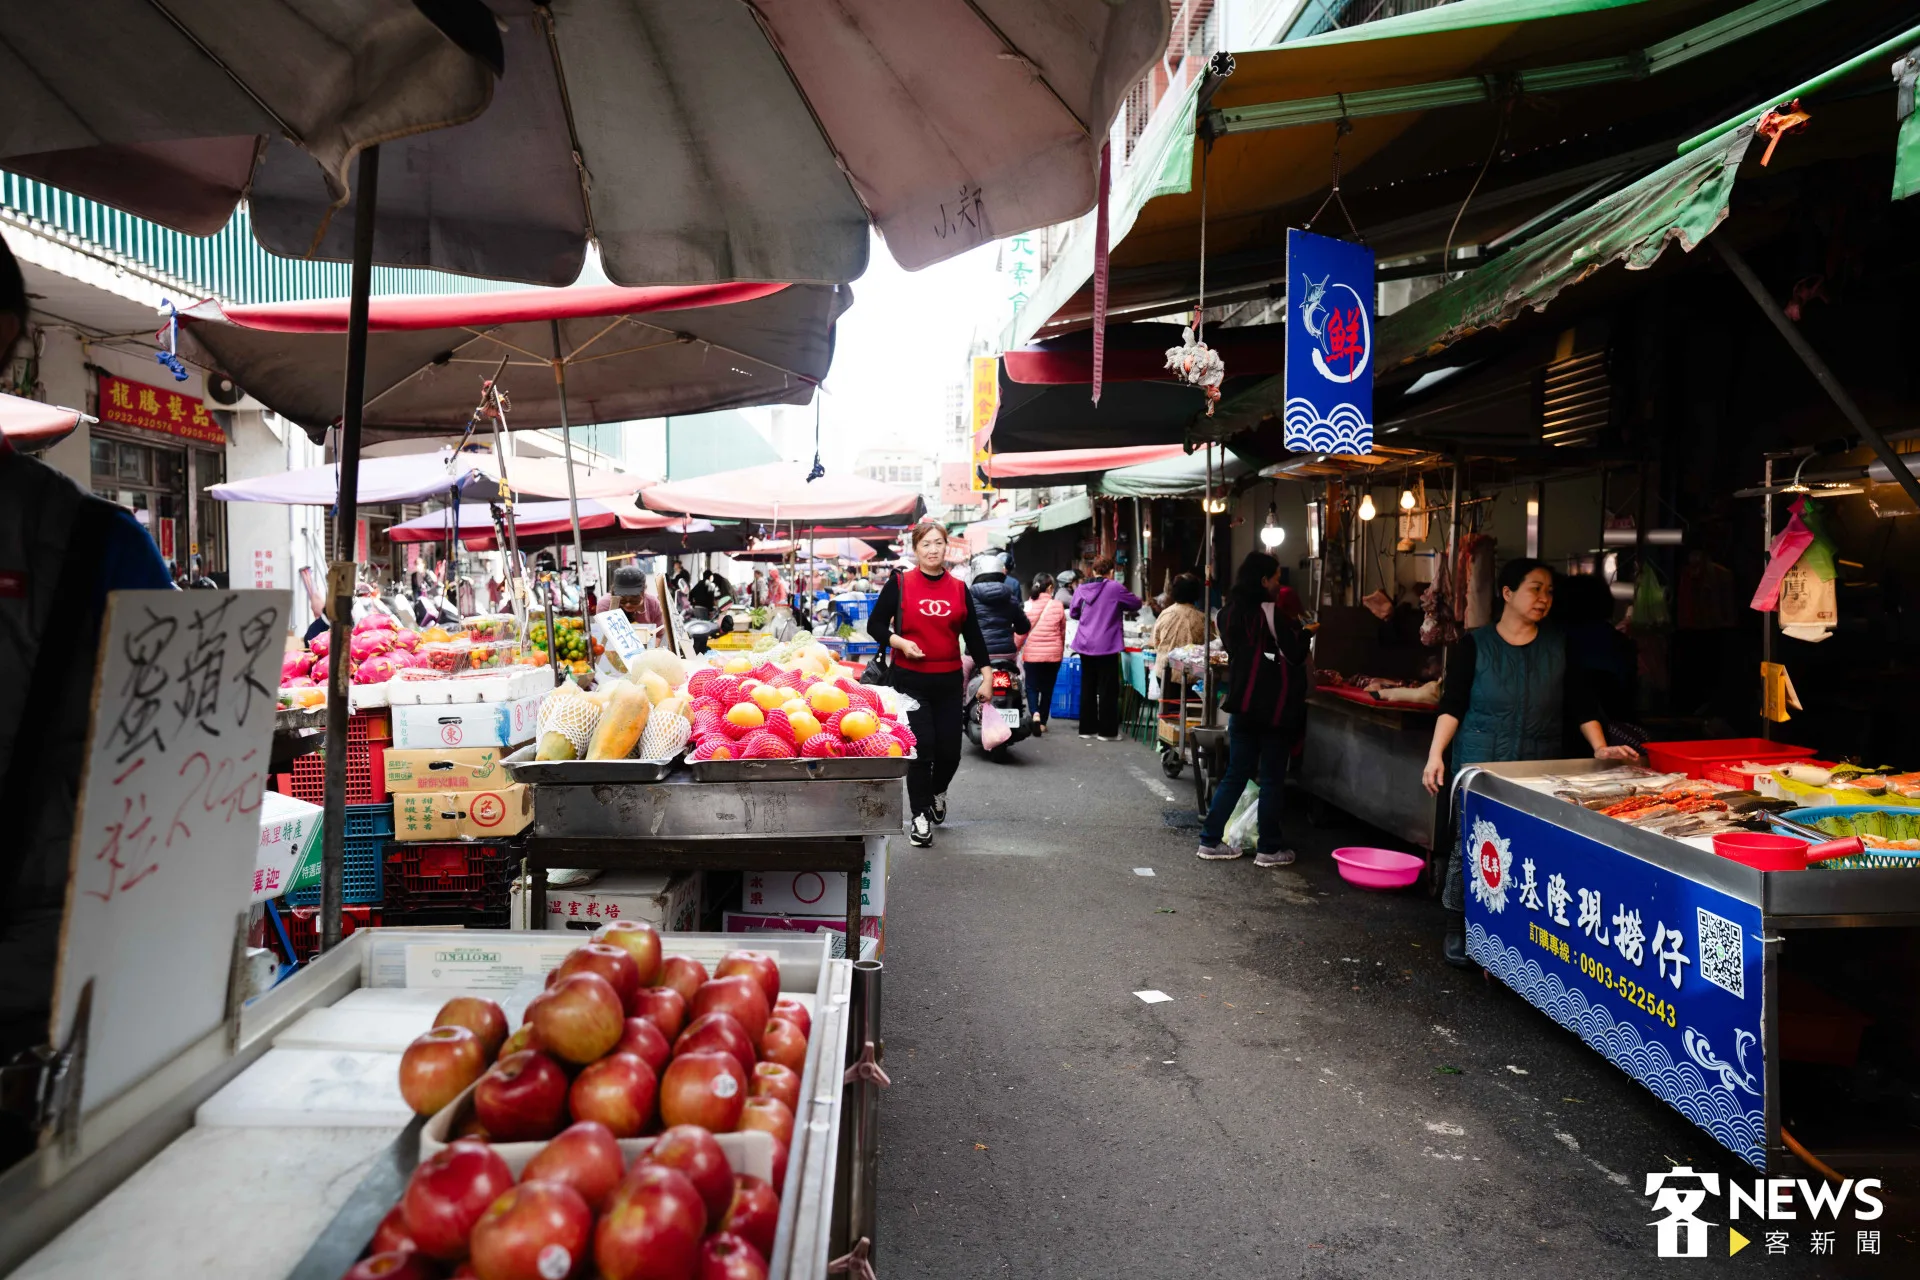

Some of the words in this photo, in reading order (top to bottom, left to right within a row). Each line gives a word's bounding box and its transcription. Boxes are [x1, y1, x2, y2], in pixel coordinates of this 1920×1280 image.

[1326, 306, 1364, 385] 鮮
[445, 725, 459, 743] 東
[1518, 856, 1691, 990] 基隆現撈仔
